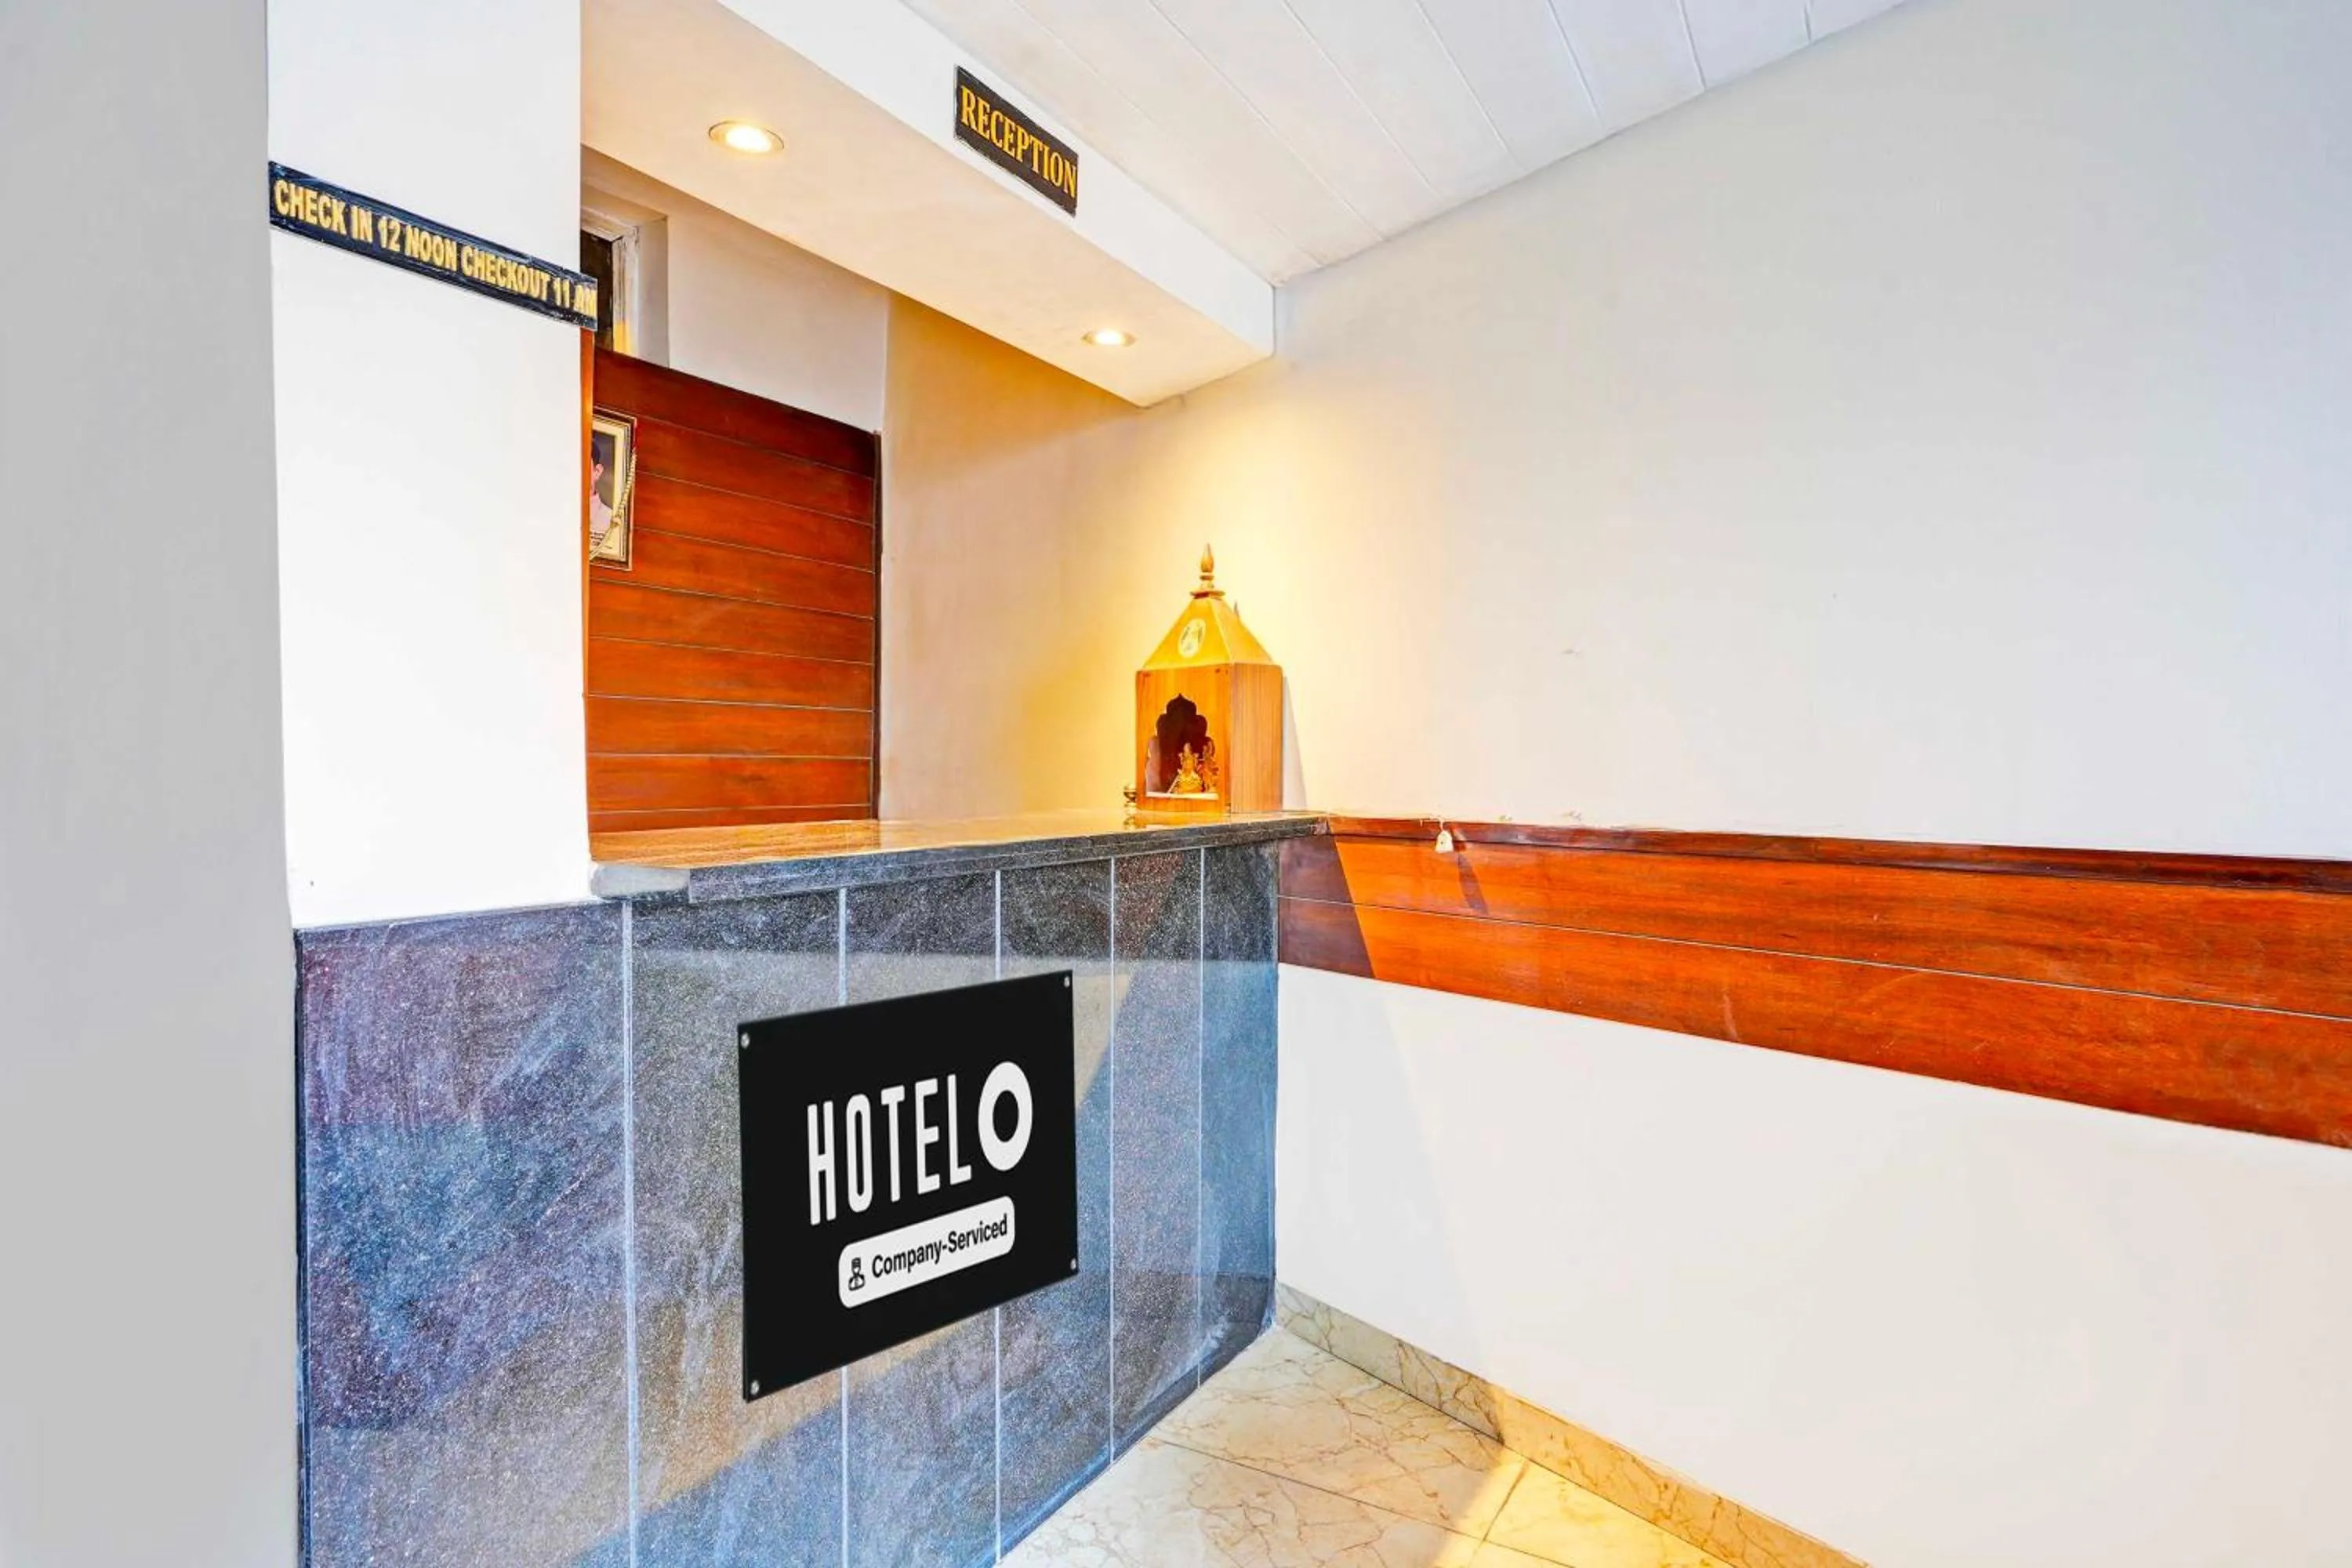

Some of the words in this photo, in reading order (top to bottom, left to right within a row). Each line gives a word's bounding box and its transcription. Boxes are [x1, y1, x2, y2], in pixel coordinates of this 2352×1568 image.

[960, 85, 1076, 198] RECEPTION
[274, 180, 347, 234] CHECK
[350, 205, 372, 242] IN
[378, 216, 401, 252] 12
[405, 223, 457, 272] NOON
[461, 245, 550, 301] CHECKOUT
[553, 277, 570, 309] 11
[573, 285, 597, 318] AM
[808, 1074, 971, 1225] HOTEL
[872, 1214, 1007, 1279] Company-Serviced
